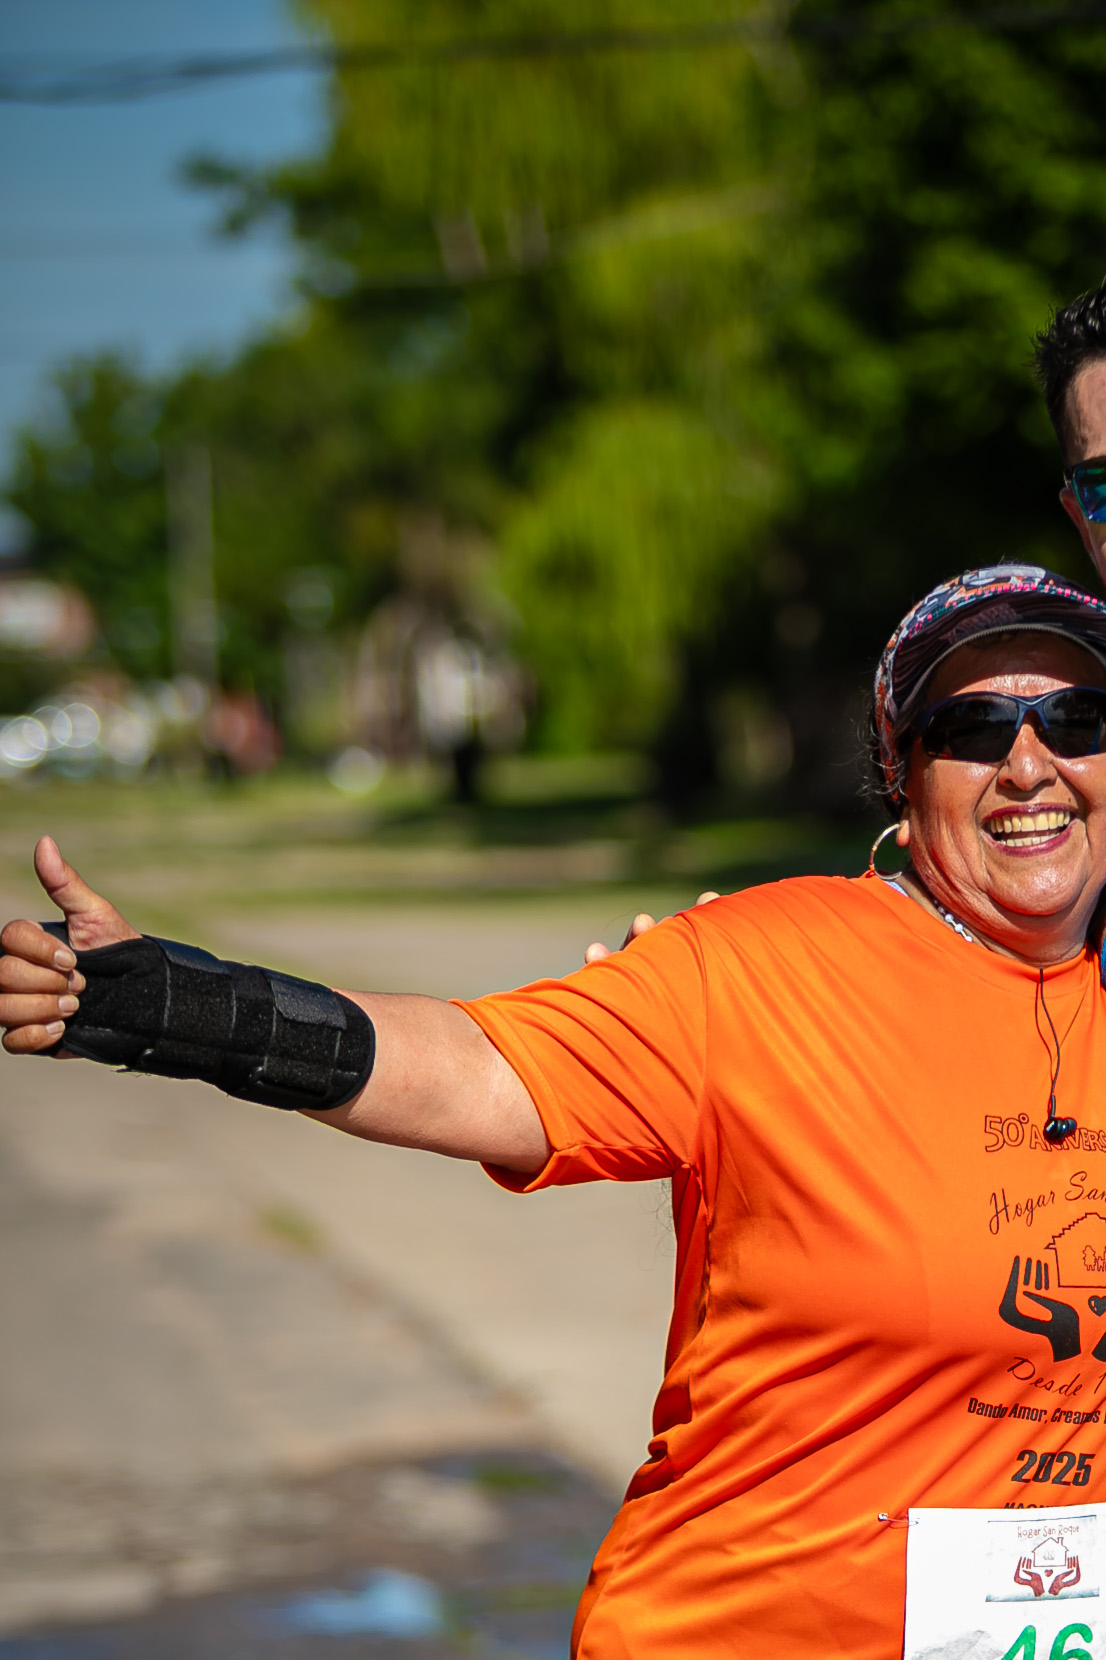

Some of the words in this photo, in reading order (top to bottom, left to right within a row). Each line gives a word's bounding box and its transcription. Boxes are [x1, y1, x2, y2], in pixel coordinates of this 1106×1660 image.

[988, 1187, 1056, 1235] Hogar
[1006, 1356, 1082, 1398] Desde
[967, 1397, 1008, 1419] Dando
[1007, 1402, 1048, 1424] Amor,
[1011, 1448, 1096, 1487] 2025
[1017, 1526, 1041, 1539] Hogar
[1042, 1525, 1057, 1538] San
[1058, 1524, 1080, 1536] Roque
